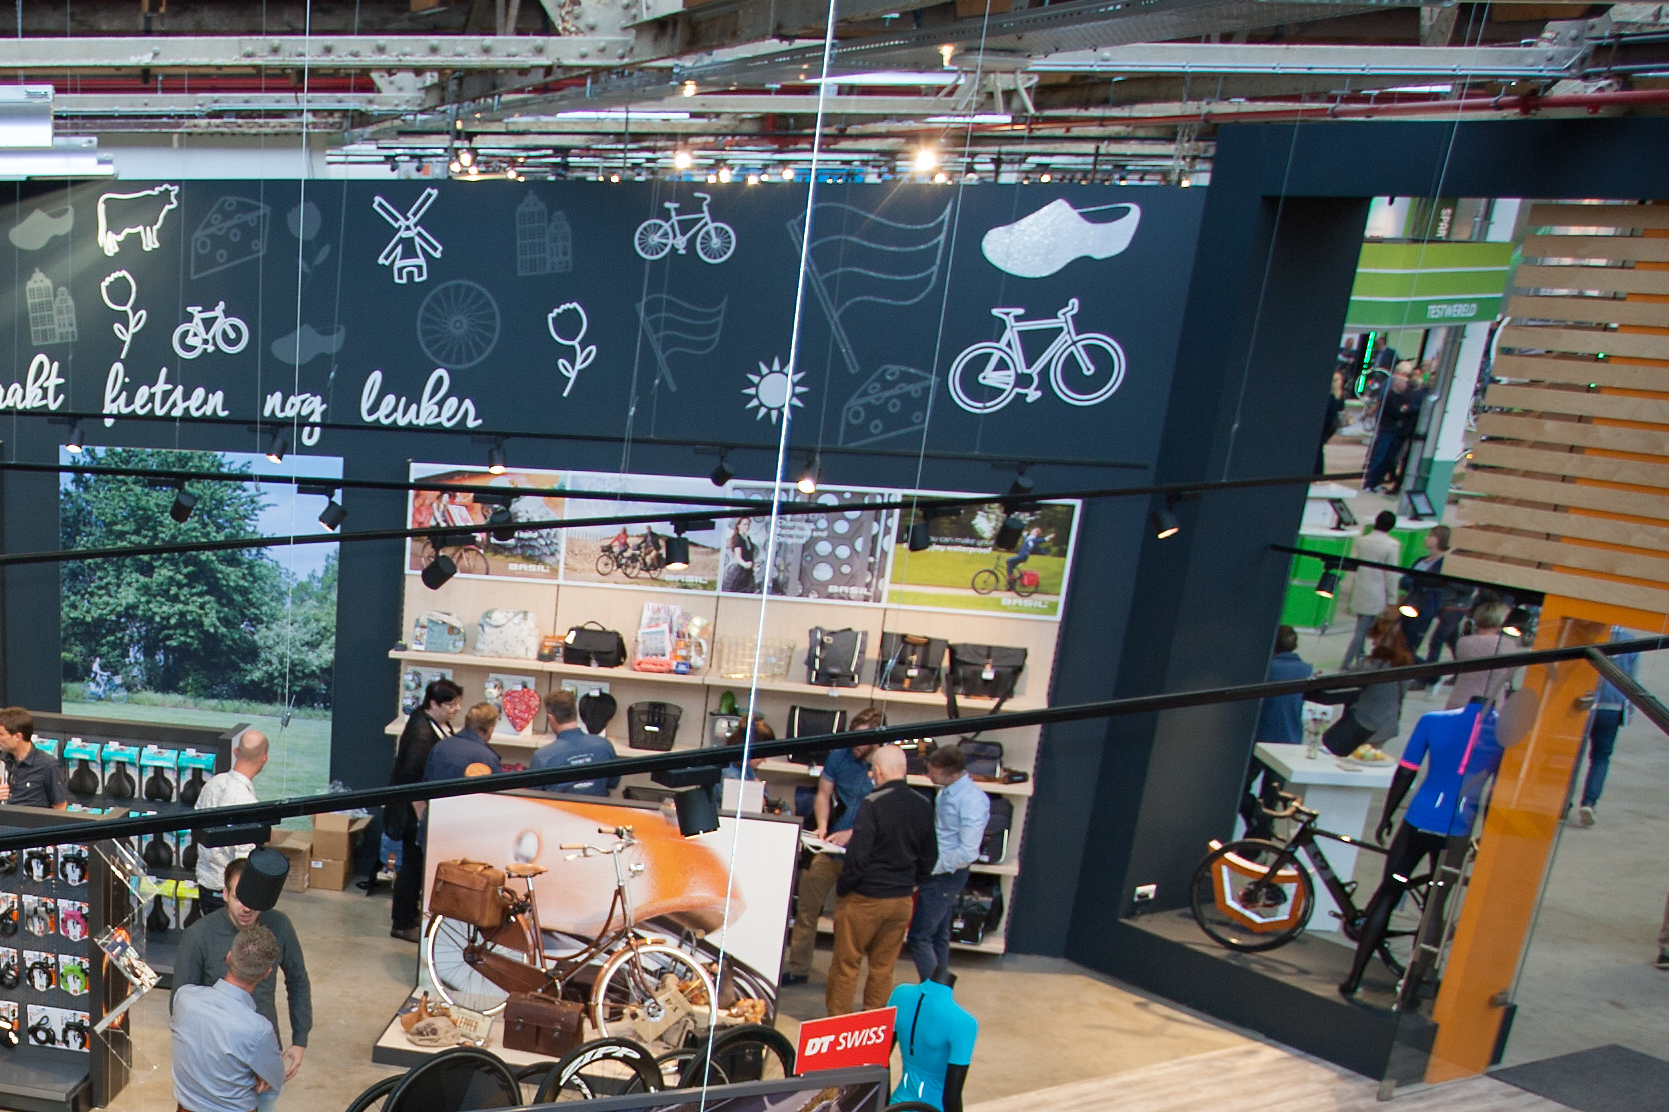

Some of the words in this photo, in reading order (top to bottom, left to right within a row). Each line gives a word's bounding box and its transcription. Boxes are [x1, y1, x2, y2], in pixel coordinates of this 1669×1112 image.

[1427, 303, 1478, 319] TESTWERELD
[102, 361, 230, 427] fietsen
[264, 389, 328, 446] nog
[360, 367, 483, 429] leuker
[455, 1015, 479, 1033] LEPPER
[804, 1035, 835, 1056] DT
[836, 1025, 887, 1050] SWISS
[559, 1045, 641, 1086] ZIPP
